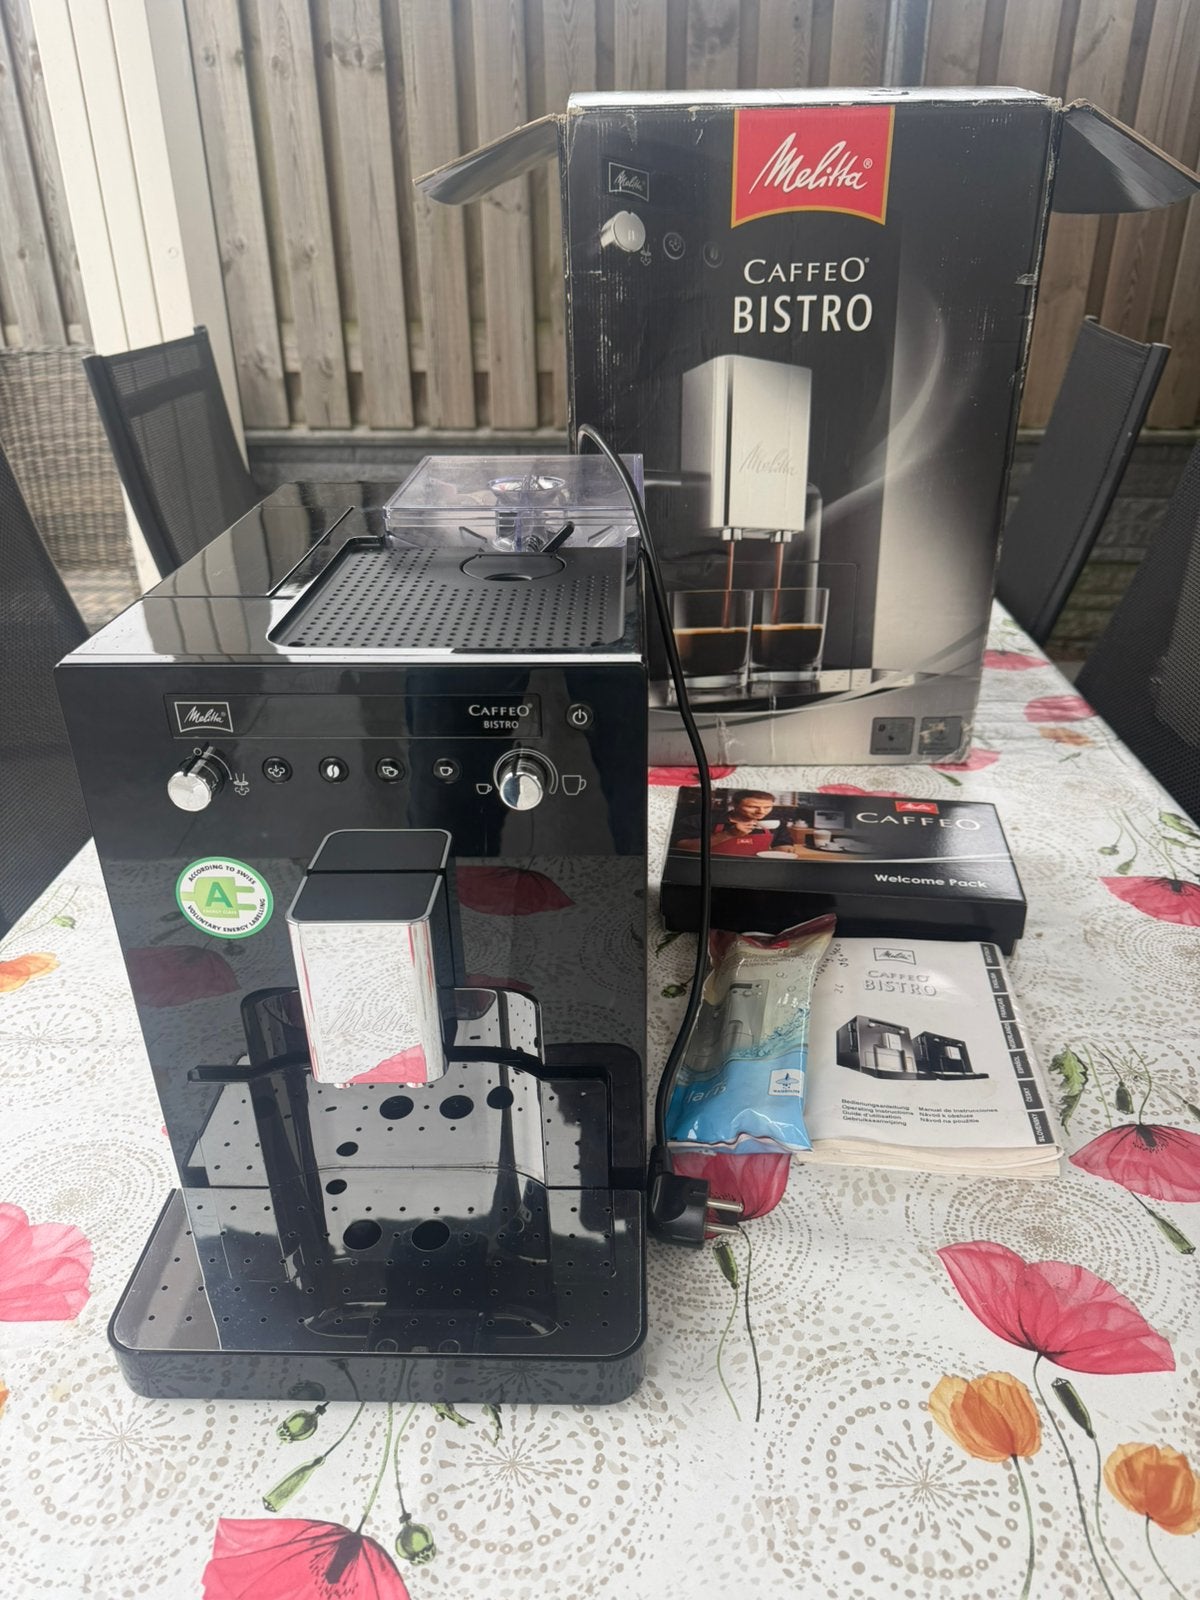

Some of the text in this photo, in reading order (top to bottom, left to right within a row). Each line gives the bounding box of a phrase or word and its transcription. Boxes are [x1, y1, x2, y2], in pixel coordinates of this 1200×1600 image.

[733, 293, 873, 333] BISTRO
[483, 720, 519, 729] BISTRO
[856, 812, 980, 831] CAFFEO
[188, 864, 223, 882] ACCORDING
[236, 869, 256, 885] SWISS
[874, 873, 989, 889] Welcome Pack
[205, 881, 233, 908] A
[188, 898, 266, 933] VOLUNTARY ENERGY LABELLING
[865, 980, 937, 997] BISTRO
[841, 1099, 910, 1111] Bedienungsanleitung
[842, 1105, 874, 1113] Operating
